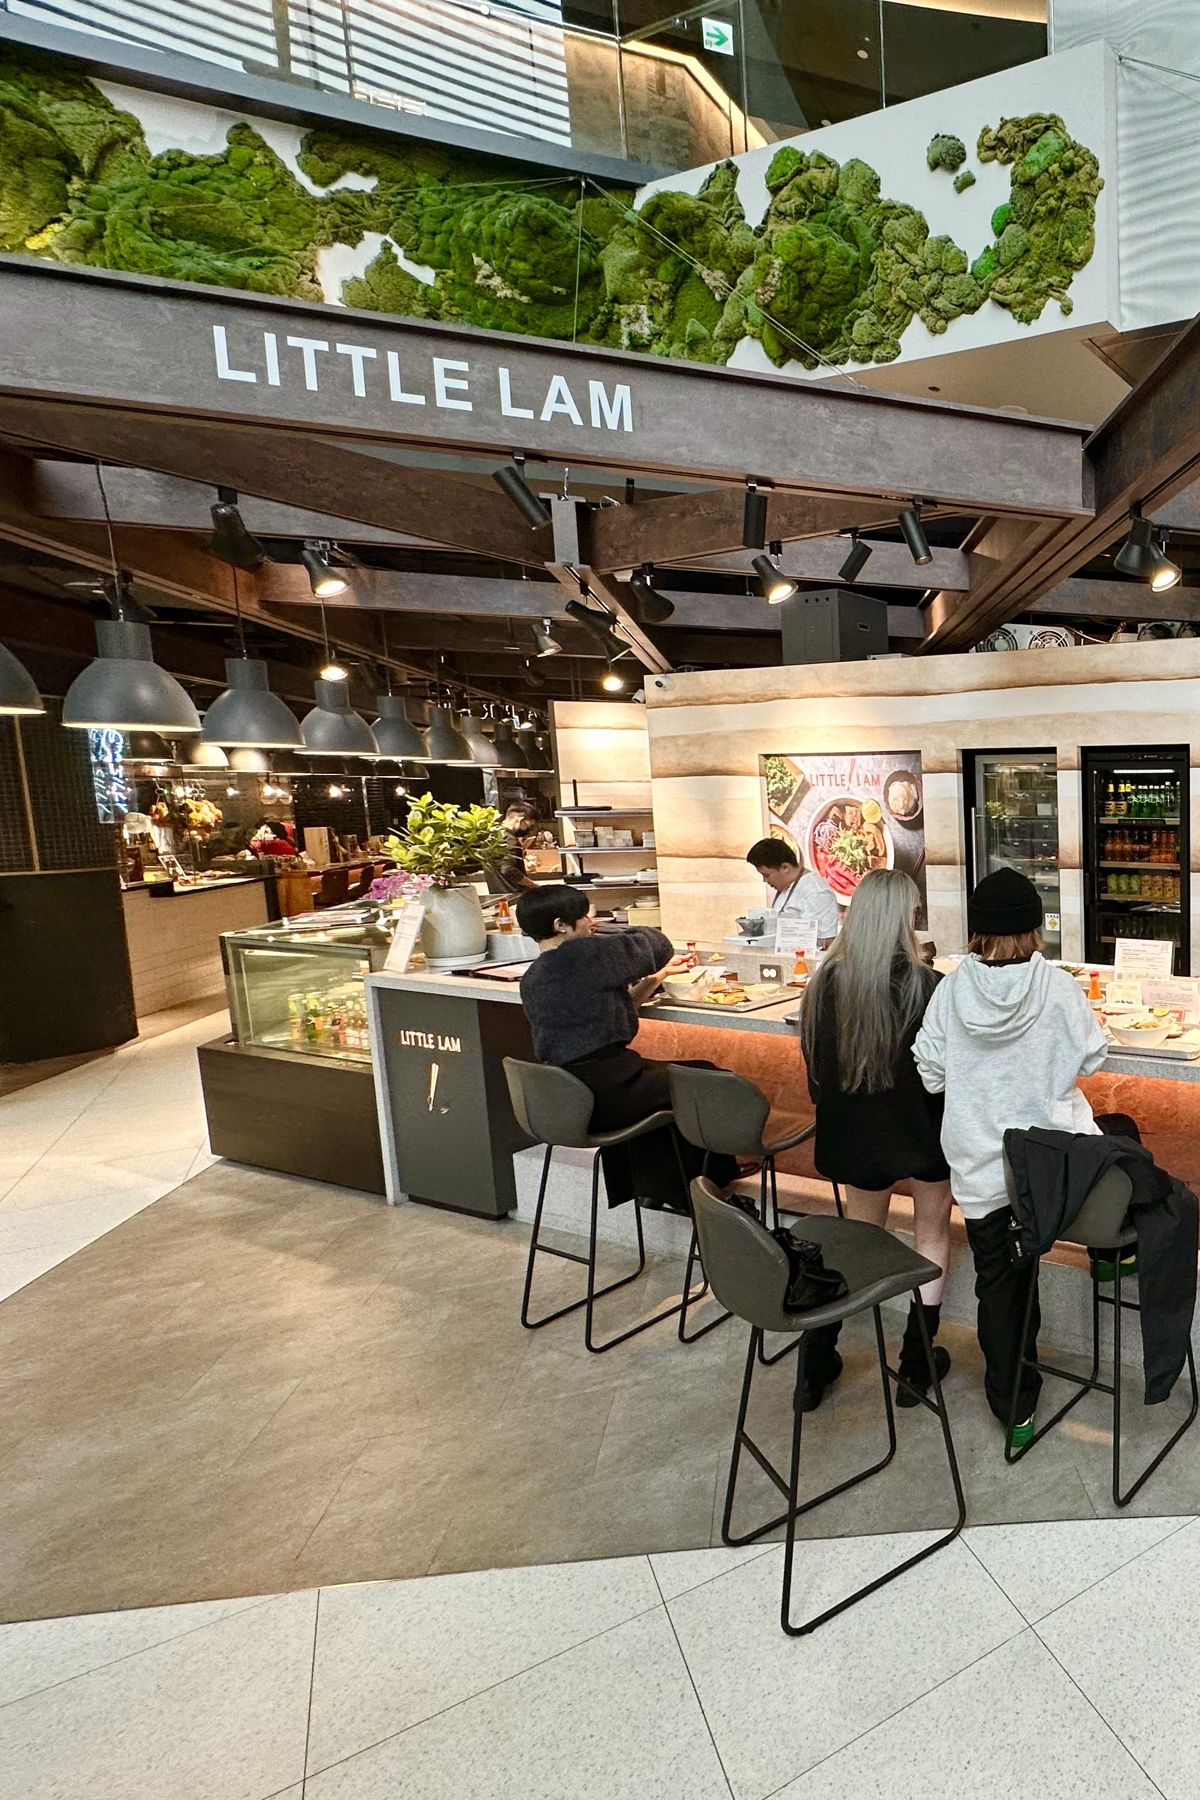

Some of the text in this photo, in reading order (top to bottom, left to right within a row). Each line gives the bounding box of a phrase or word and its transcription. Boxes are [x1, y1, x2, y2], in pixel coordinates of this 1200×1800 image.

[212, 325, 634, 433] LITTLE LAM
[809, 773, 846, 787] LITTLE
[400, 1029, 461, 1053] LITTLE LAM
